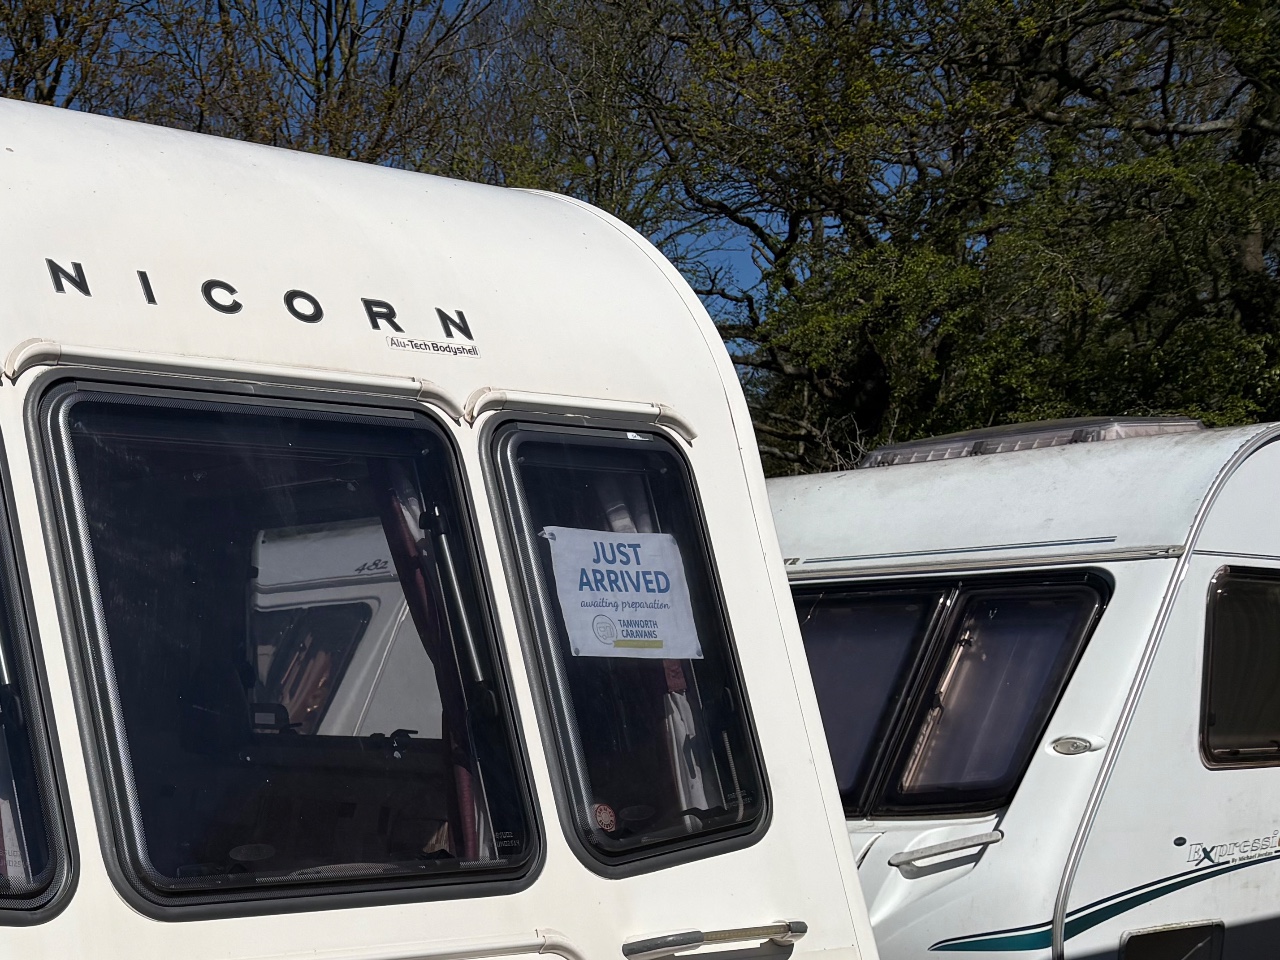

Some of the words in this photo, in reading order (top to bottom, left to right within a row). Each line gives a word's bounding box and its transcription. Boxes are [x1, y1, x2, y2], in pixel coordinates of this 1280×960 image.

[390, 337, 430, 351] Alu-Tech
[431, 343, 478, 356] Bodyshell
[593, 542, 641, 565] JUST
[355, 559, 388, 573] 482
[579, 568, 670, 593] ARRIVED
[581, 598, 619, 611] awaiting
[622, 599, 670, 611] preparation
[618, 619, 658, 629] TAMWORTH
[622, 629, 658, 639] CARAVANS
[1186, 829, 1280, 866] Expressi
